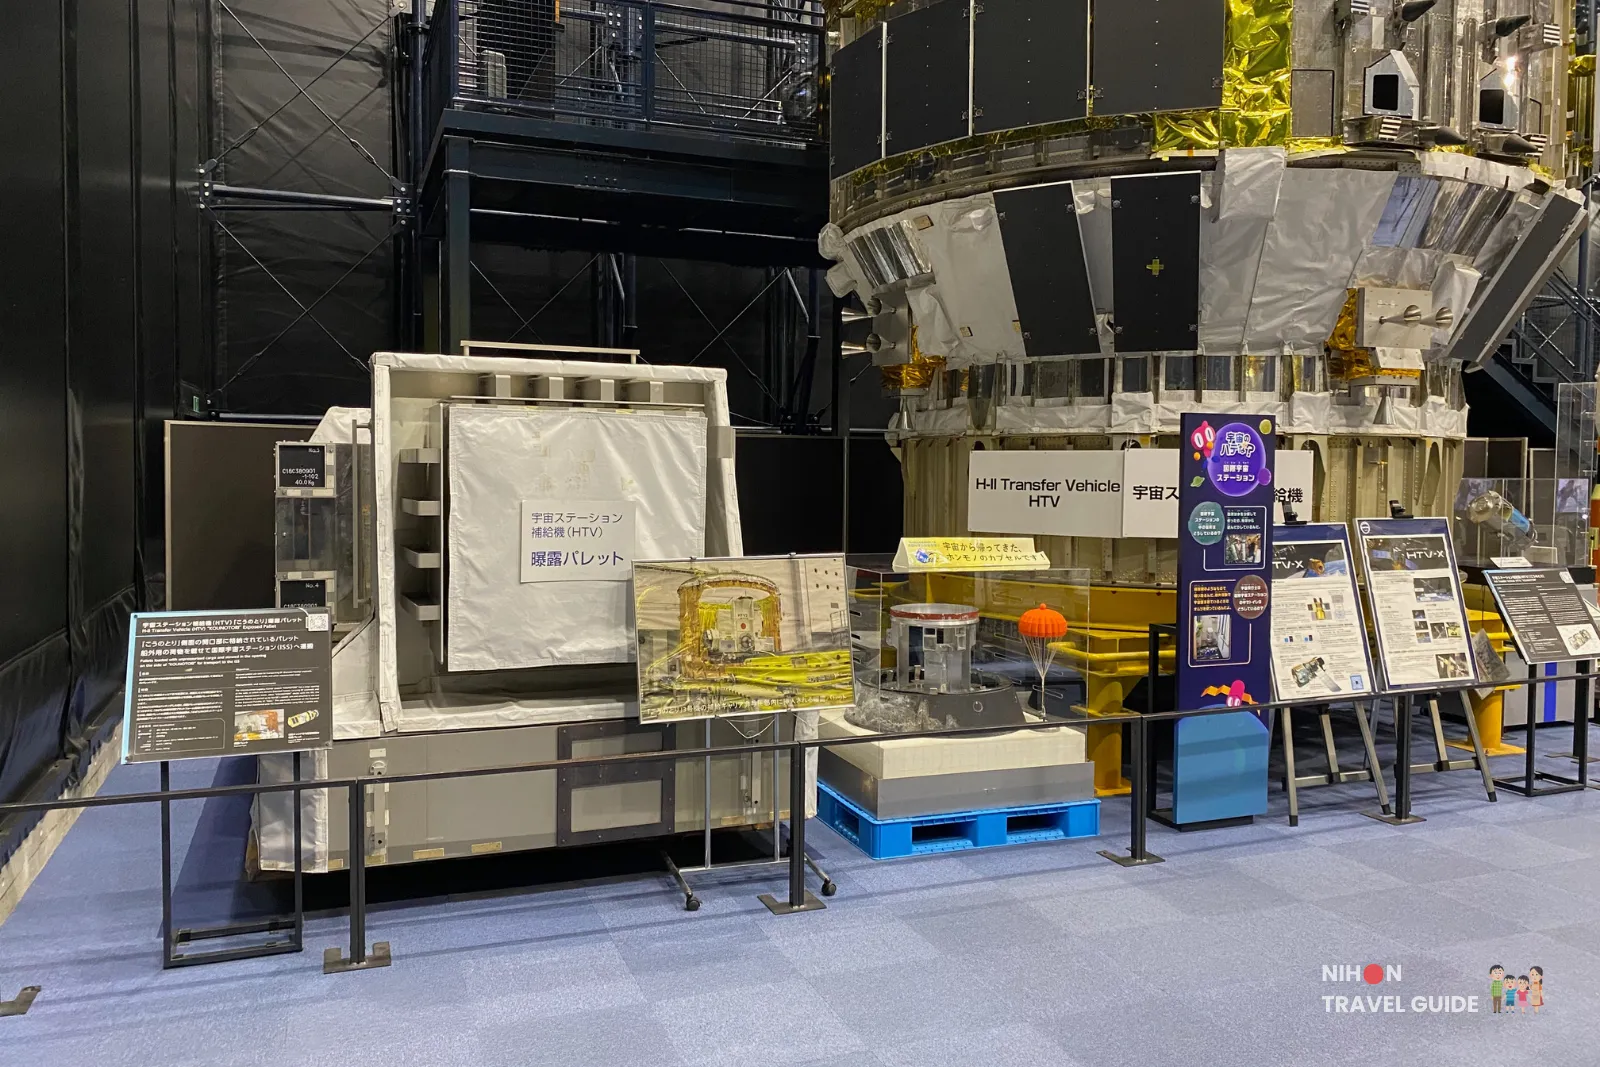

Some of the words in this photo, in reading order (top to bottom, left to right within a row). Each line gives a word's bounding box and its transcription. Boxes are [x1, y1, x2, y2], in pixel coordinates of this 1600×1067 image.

[1225, 431, 1251, 443] 宇宙の
[1216, 474, 1255, 482] ステーション
[976, 478, 997, 490] H-II
[1000, 478, 1061, 492] Transfer
[1065, 479, 1121, 493] Vehicle
[1029, 495, 1061, 508] HTV
[531, 512, 623, 524] 宇宙ステーション
[531, 550, 624, 567] 曝露パレット
